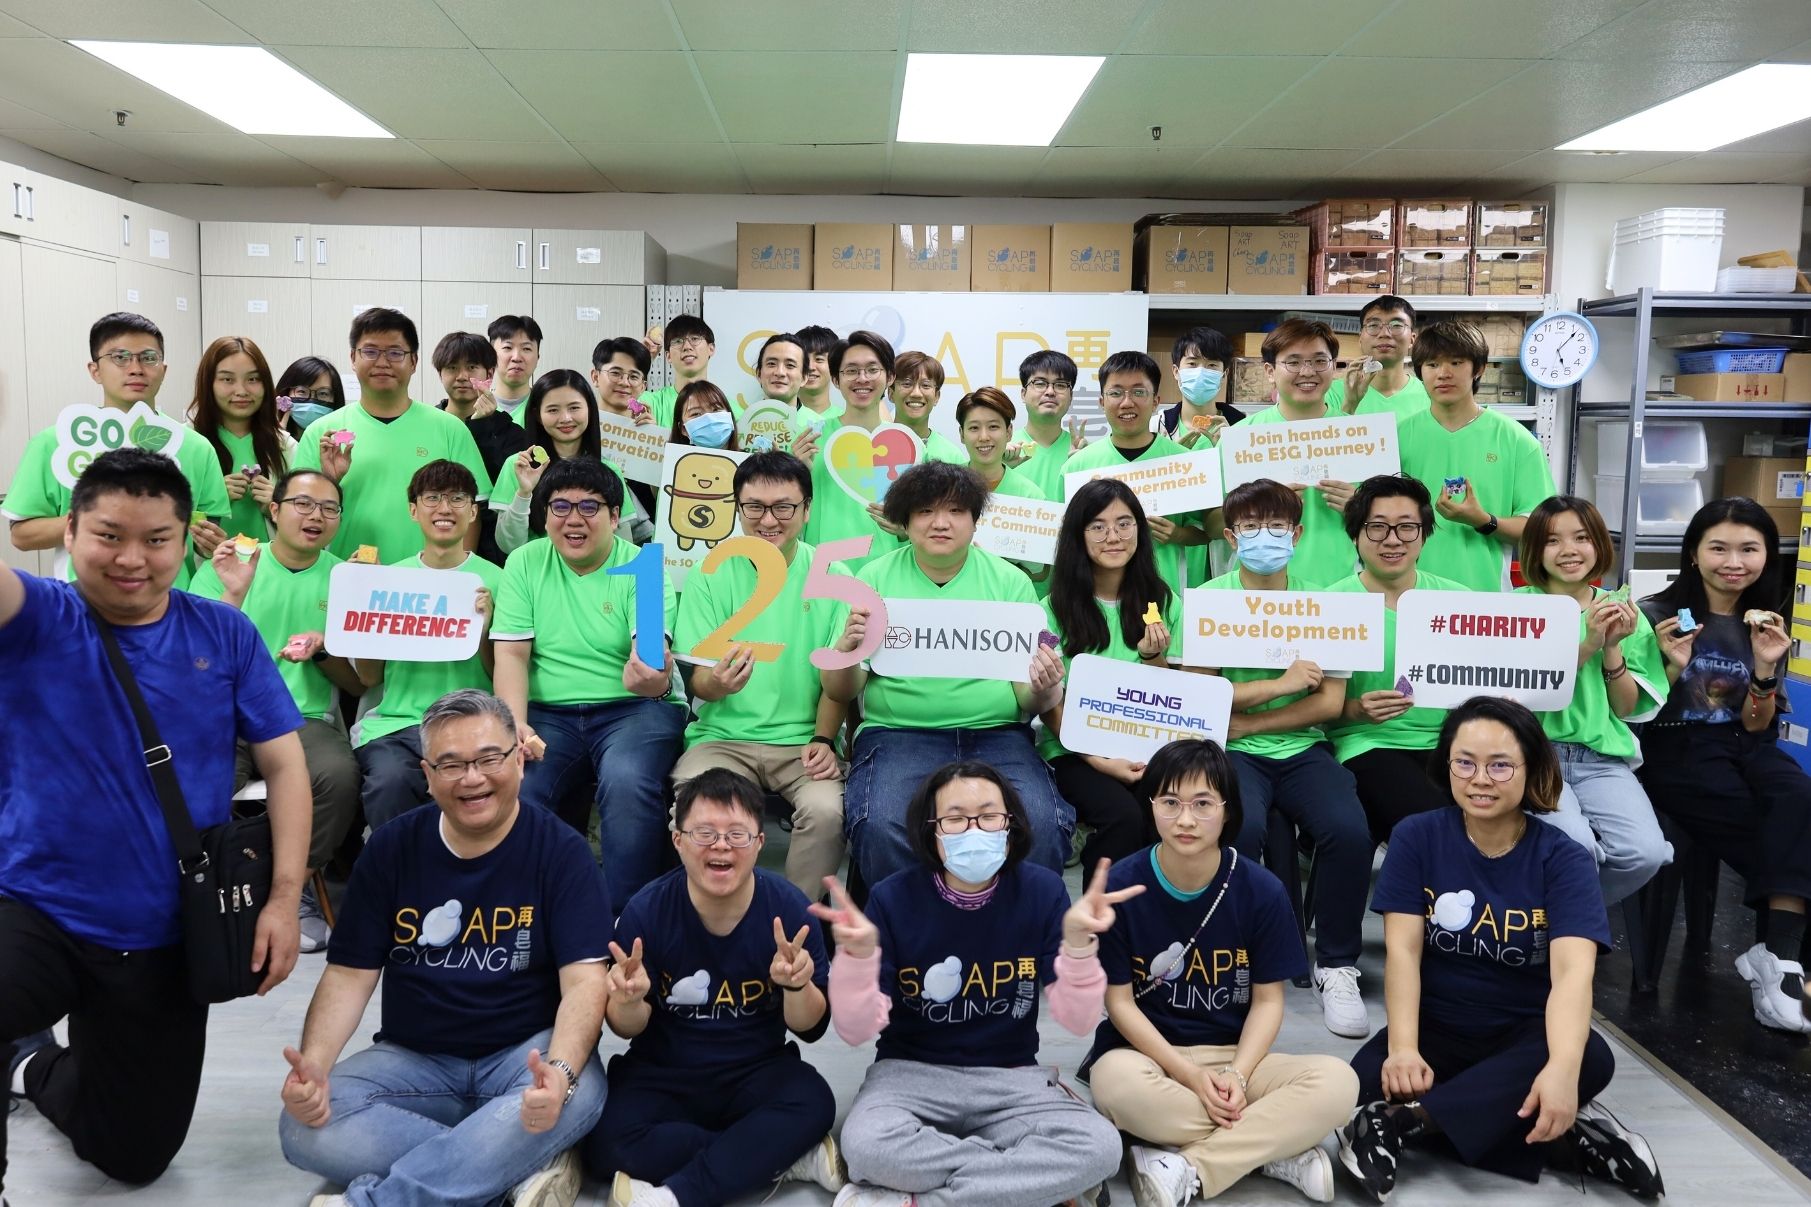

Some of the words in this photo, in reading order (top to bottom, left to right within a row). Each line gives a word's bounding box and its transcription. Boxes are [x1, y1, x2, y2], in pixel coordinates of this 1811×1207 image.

[751, 244, 793, 261] SOAP
[832, 244, 873, 260] SOAP
[988, 247, 1029, 263] SOAP
[1070, 246, 1113, 262] SOAP
[1166, 247, 1207, 263] SOAP
[751, 260, 792, 270] CYCLING
[832, 261, 873, 270] CYCLING
[987, 263, 1028, 272] CYCLING
[1070, 263, 1112, 272] CYCLING
[1165, 263, 1206, 273] CYCLING
[1544, 324, 1552, 333] 11
[1556, 320, 1566, 330] 12
[1534, 333, 1544, 342] 10
[1577, 332, 1585, 342] 2
[1529, 345, 1537, 354] 9
[1578, 345, 1586, 354] 3
[1531, 358, 1539, 367] 8
[1573, 358, 1581, 366] 4
[1540, 367, 1547, 375] 7
[1550, 370, 1558, 378] 6
[1563, 366, 1571, 375] 5
[70, 415, 125, 449] GO
[1250, 431, 1283, 447] Join
[1288, 425, 1341, 443] hands
[1346, 425, 1368, 437] on
[1235, 450, 1264, 464] the
[1268, 445, 1302, 461] ESG
[1307, 441, 1376, 460] Journey
[1380, 437, 1386, 451] !
[1091, 461, 1193, 483] mmunity
[1036, 508, 1057, 522] for
[368, 590, 430, 614] MAKE
[432, 595, 448, 616] A
[1245, 596, 1321, 616] Youth
[343, 610, 471, 638] DIFFERENCE
[1198, 617, 1369, 642] Development
[1430, 614, 1546, 639] #CHARITY
[915, 627, 1033, 654] HANISON
[1116, 687, 1182, 710] YOUNG
[1079, 697, 1212, 731] PROFESSIONAL
[394, 899, 516, 947] SOAP
[1425, 924, 1526, 966] YCLING
[389, 945, 508, 972] CYCLING
[898, 955, 1015, 1003] SOAP
[1134, 979, 1230, 1012] LING
[902, 996, 1010, 1023] CYCLING
